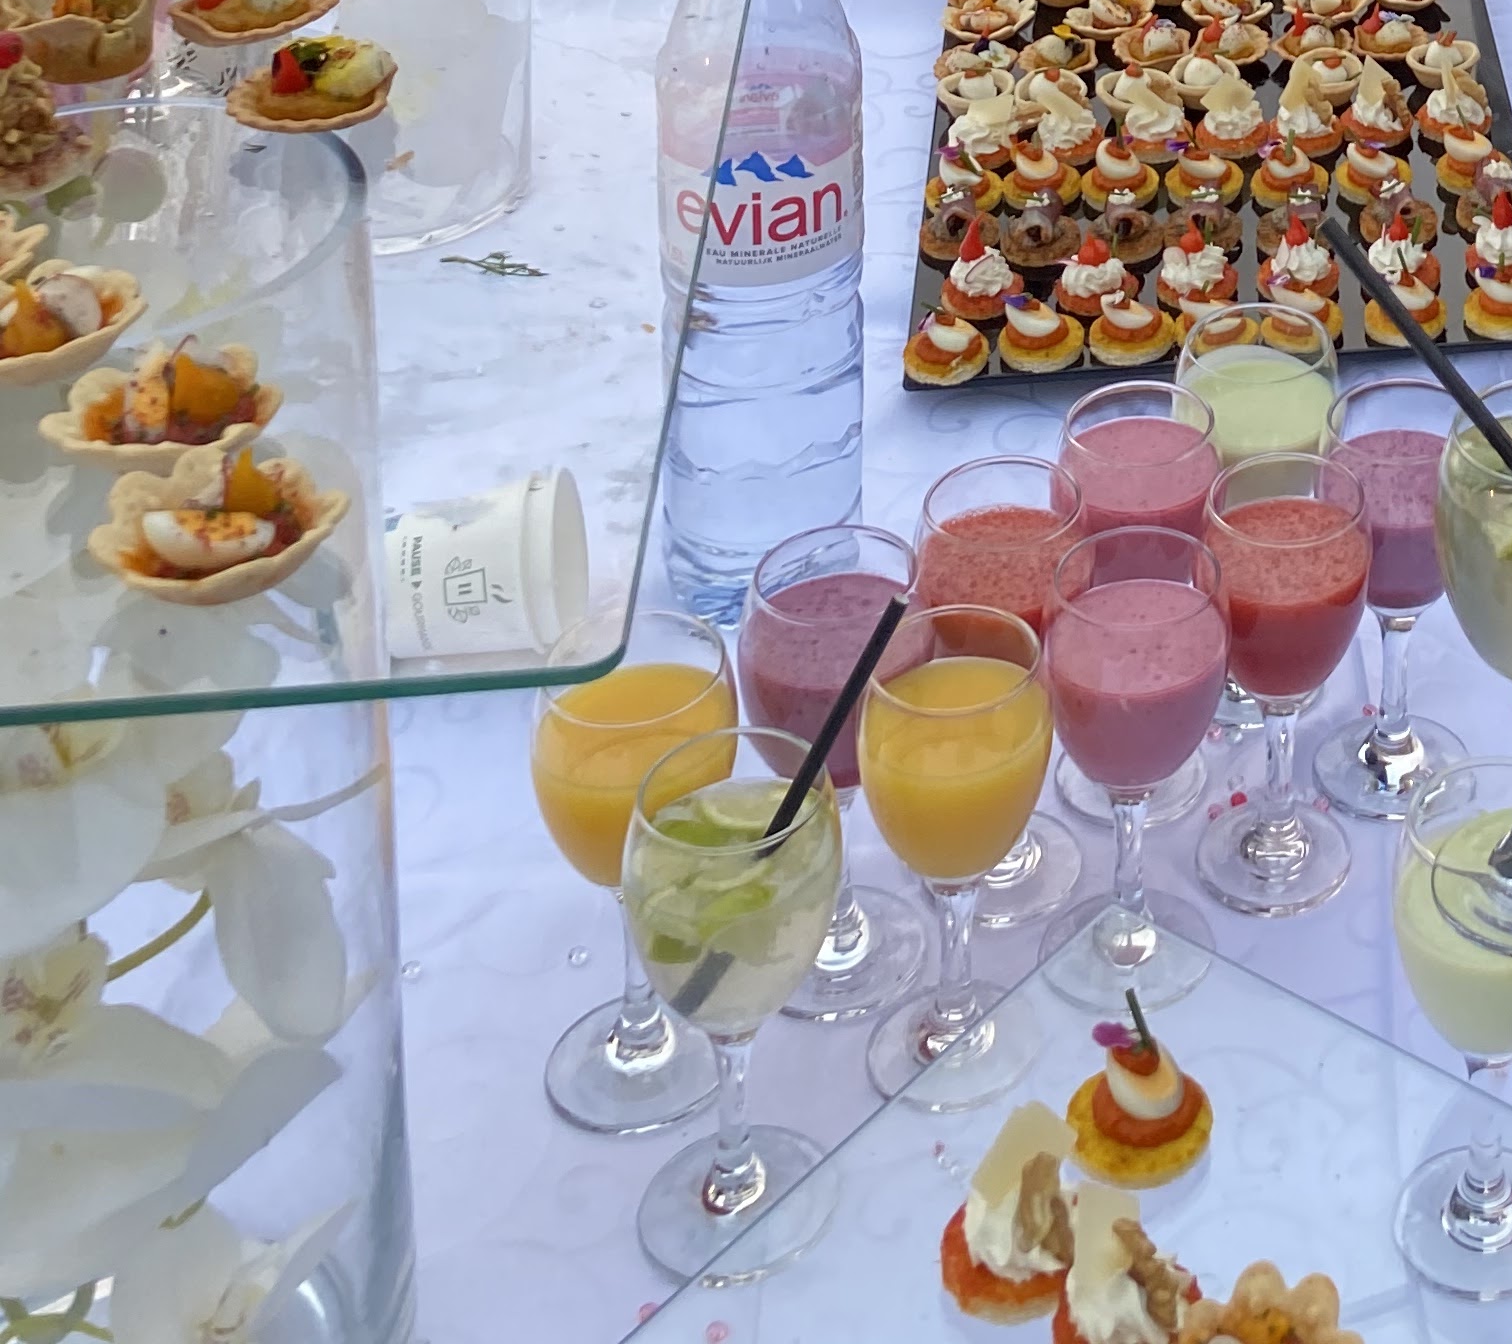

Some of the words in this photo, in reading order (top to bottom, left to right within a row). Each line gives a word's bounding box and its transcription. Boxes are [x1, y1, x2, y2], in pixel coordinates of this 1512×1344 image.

[676, 182, 842, 246] evian
[706, 248, 726, 257] EAU
[790, 224, 842, 251] NATURELLE
[715, 257, 773, 266] NATUURLIJK
[776, 232, 842, 262] MINERAALWATER
[410, 535, 423, 577] PAUSE
